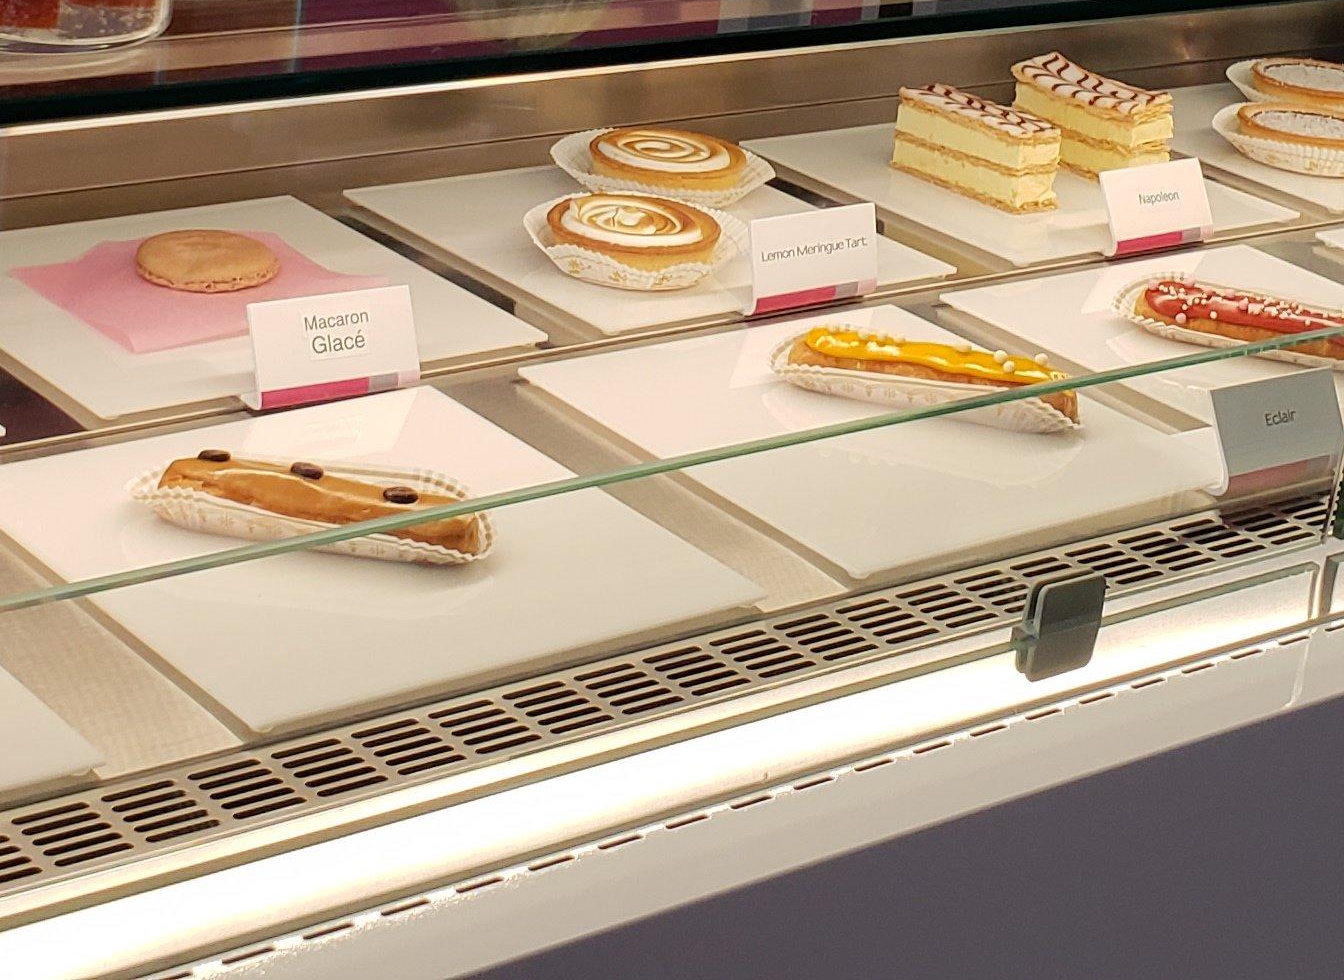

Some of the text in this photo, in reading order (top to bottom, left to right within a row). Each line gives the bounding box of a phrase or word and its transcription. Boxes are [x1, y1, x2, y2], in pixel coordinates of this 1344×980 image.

[1138, 191, 1180, 206] Napoleon
[761, 237, 868, 263] Lemon Meringue Tart
[304, 311, 369, 332] Macaron
[312, 329, 366, 354] Glacé
[1264, 409, 1297, 427] Eclair
